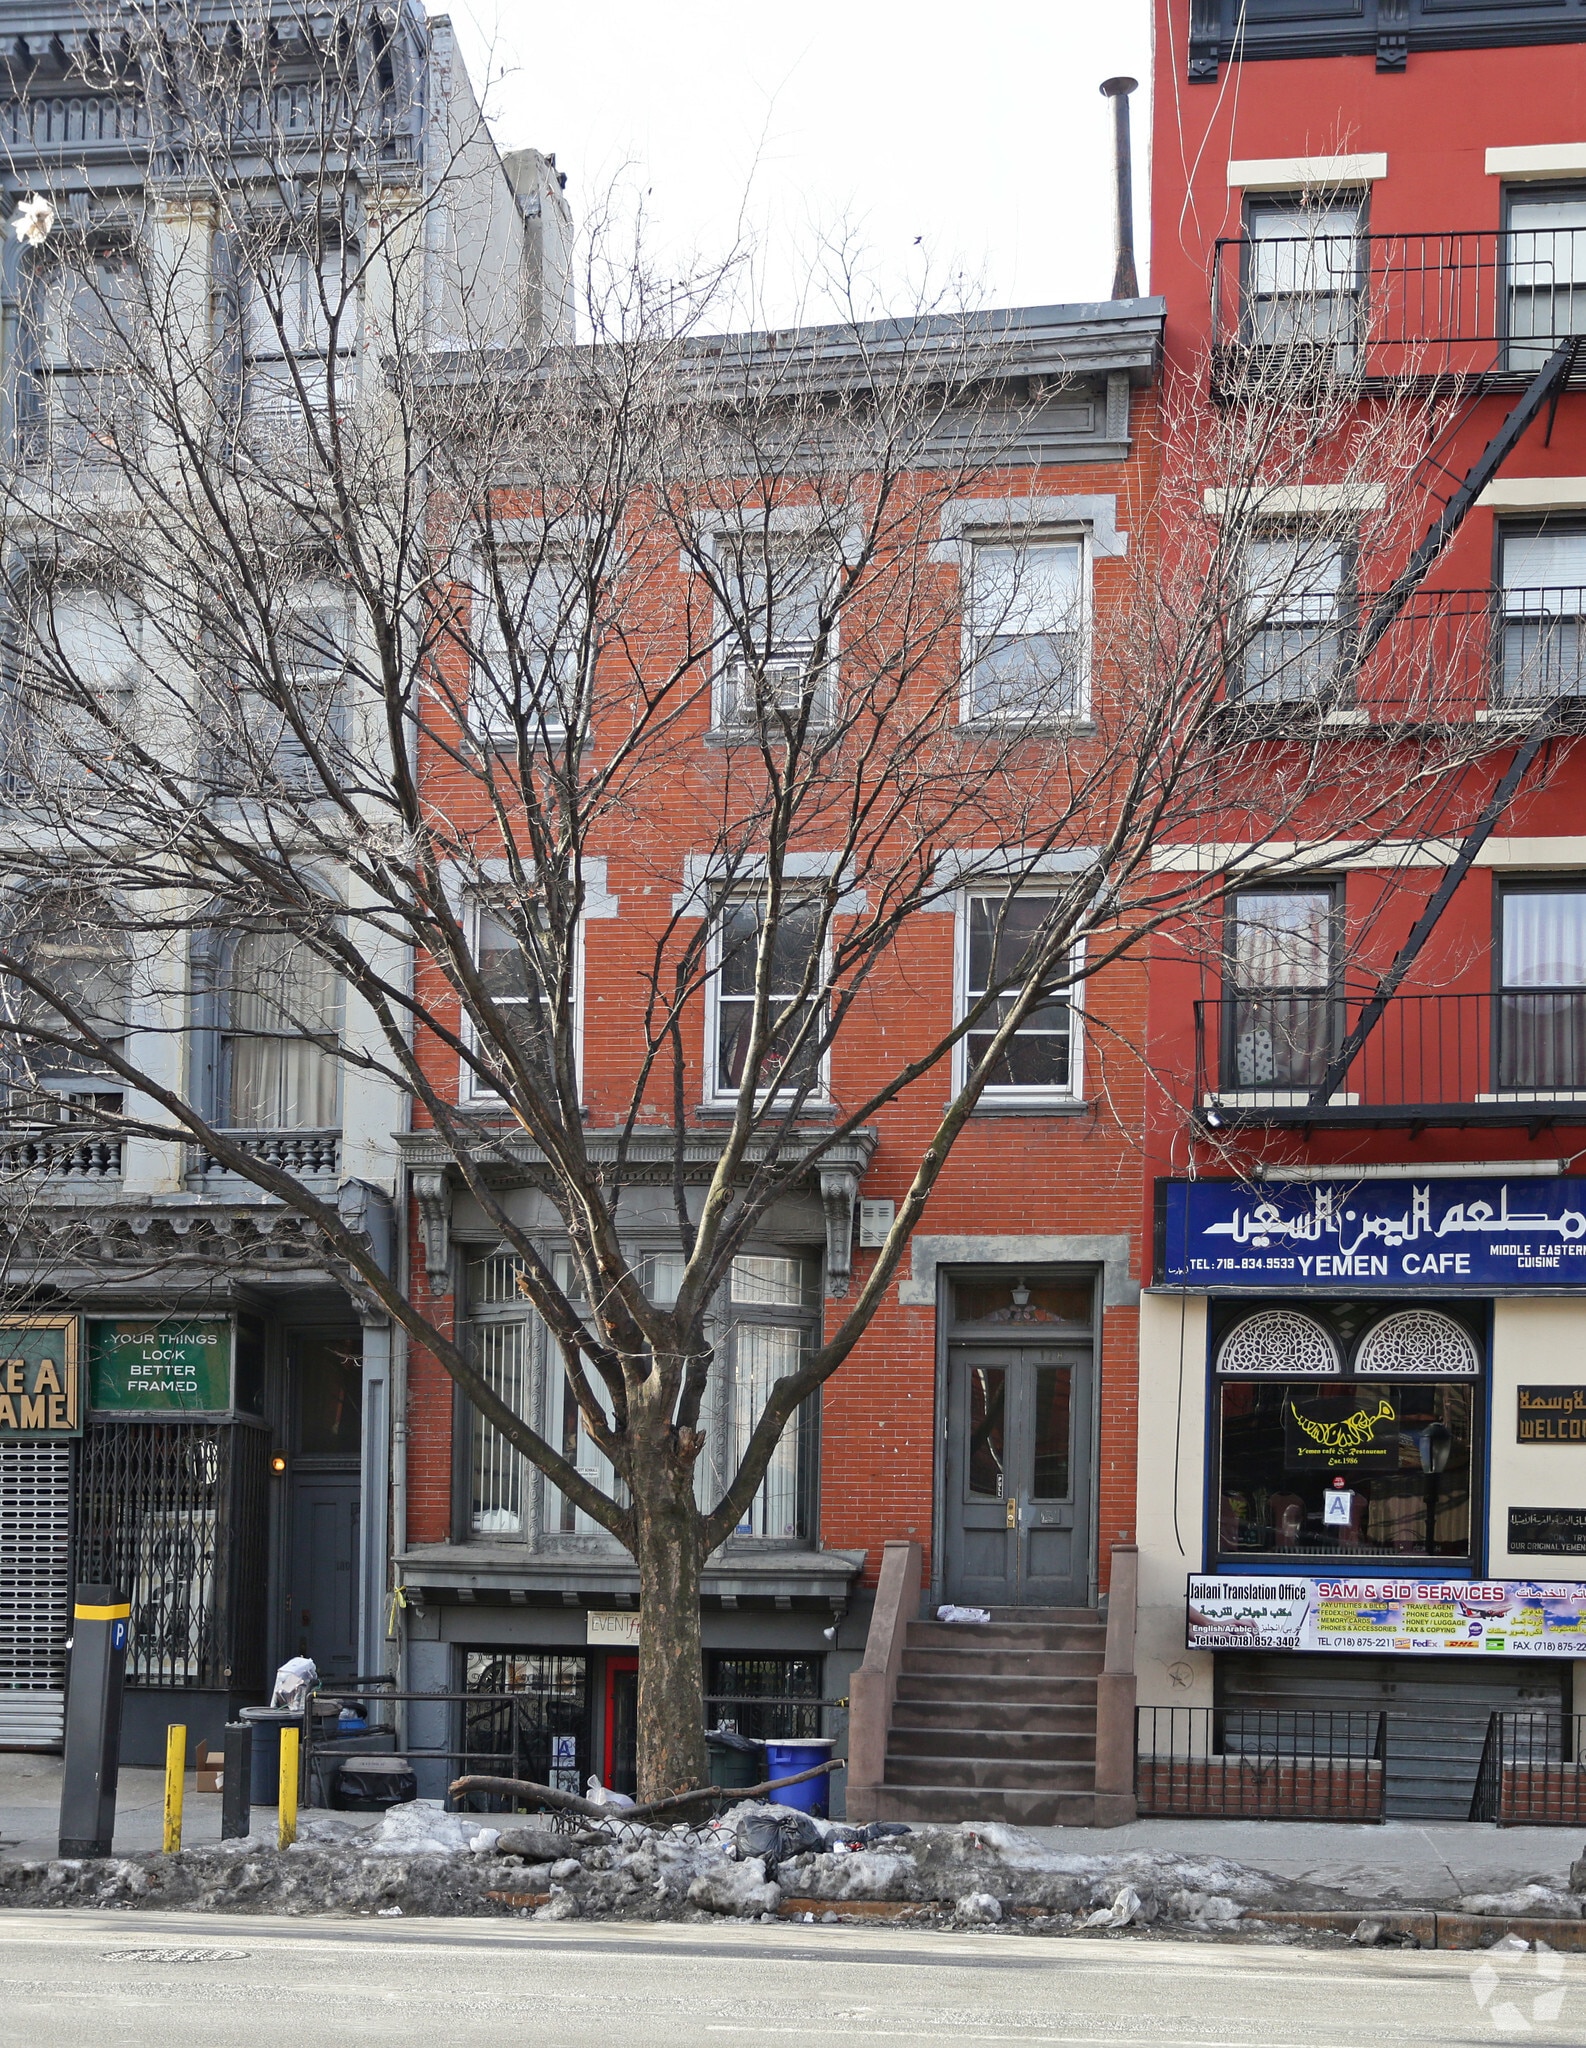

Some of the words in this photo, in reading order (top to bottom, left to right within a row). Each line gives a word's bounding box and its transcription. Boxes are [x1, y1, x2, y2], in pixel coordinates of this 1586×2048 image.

[1490, 1244, 1531, 1256] MIDDLE
[1298, 1256, 1388, 1276] YEMEN
[1402, 1253, 1471, 1275] CAFE
[1517, 1256, 1560, 1268] CUISINE
[110, 1333, 154, 1345] YOUR
[158, 1333, 218, 1345] THINGS
[142, 1349, 186, 1361] LOOK
[33, 1359, 61, 1393] A
[130, 1365, 196, 1376] BETTER
[128, 1380, 198, 1392] FRAMED
[1297, 1447, 1321, 1455] Yemen
[1348, 1448, 1387, 1456] Restaurant
[1329, 1496, 1345, 1515] A
[1510, 1542, 1525, 1550] OUR
[1527, 1542, 1560, 1550] ORIGINAL
[1190, 1583, 1220, 1599] Jailani
[1223, 1583, 1276, 1600] Translation
[1279, 1584, 1306, 1600] Office
[1319, 1584, 1358, 1598] SAM
[1364, 1584, 1377, 1598] &
[1382, 1585, 1411, 1599] SID
[1417, 1586, 1504, 1600] SERVICES
[1349, 1617, 1371, 1625] CARDS
[116, 1623, 124, 1646] P
[1192, 1625, 1252, 1634] English/Arabic
[1229, 1636, 1253, 1647] (718)
[1255, 1636, 1300, 1647] 852-3402
[1318, 1637, 1331, 1646] TEL
[1334, 1637, 1355, 1647] (718)
[1357, 1638, 1395, 1647] 875-2211
[1534, 1641, 1556, 1652] (718)
